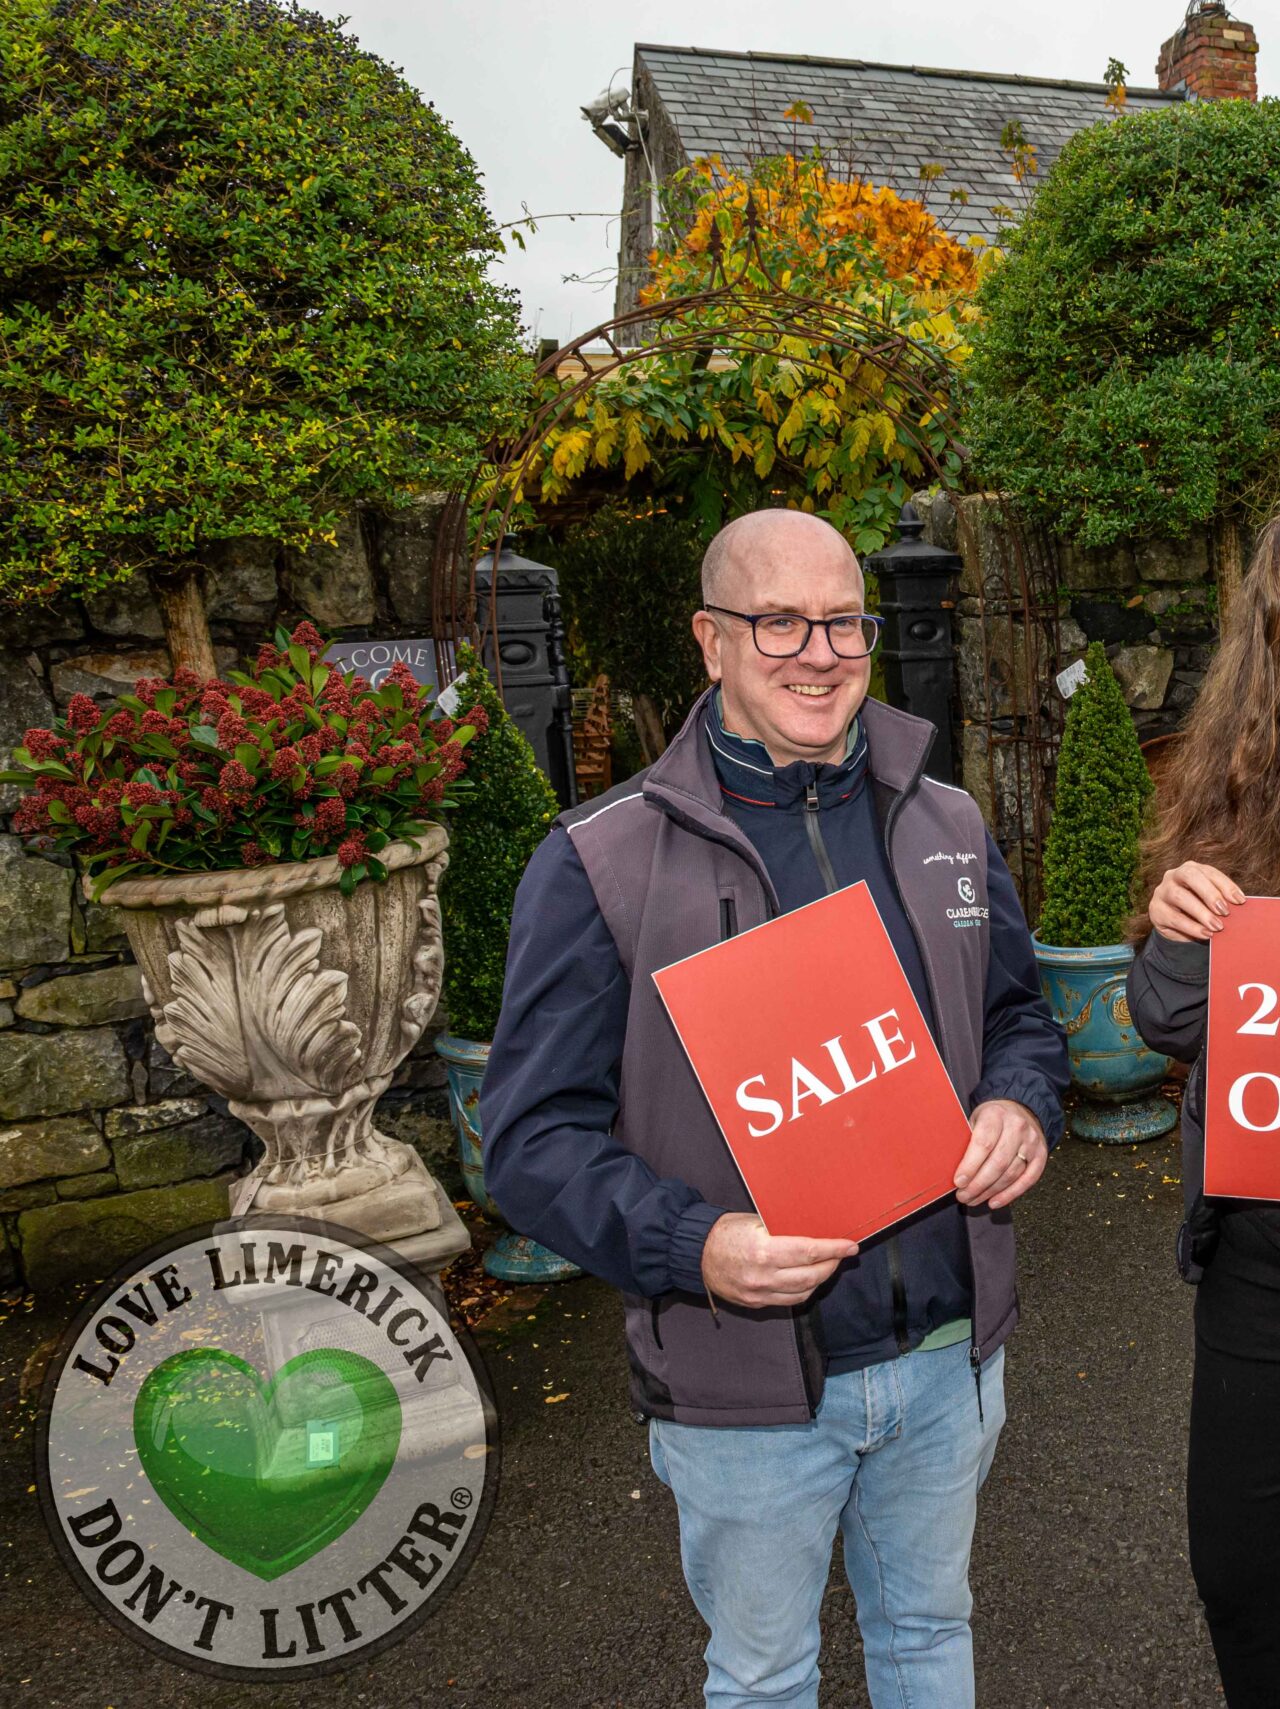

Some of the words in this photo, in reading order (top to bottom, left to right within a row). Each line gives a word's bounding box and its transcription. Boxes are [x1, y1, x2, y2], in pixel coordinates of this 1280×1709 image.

[336, 645, 428, 674] LCOME
[946, 906, 989, 919] CLARENGE
[735, 1008, 916, 1137] SALE
